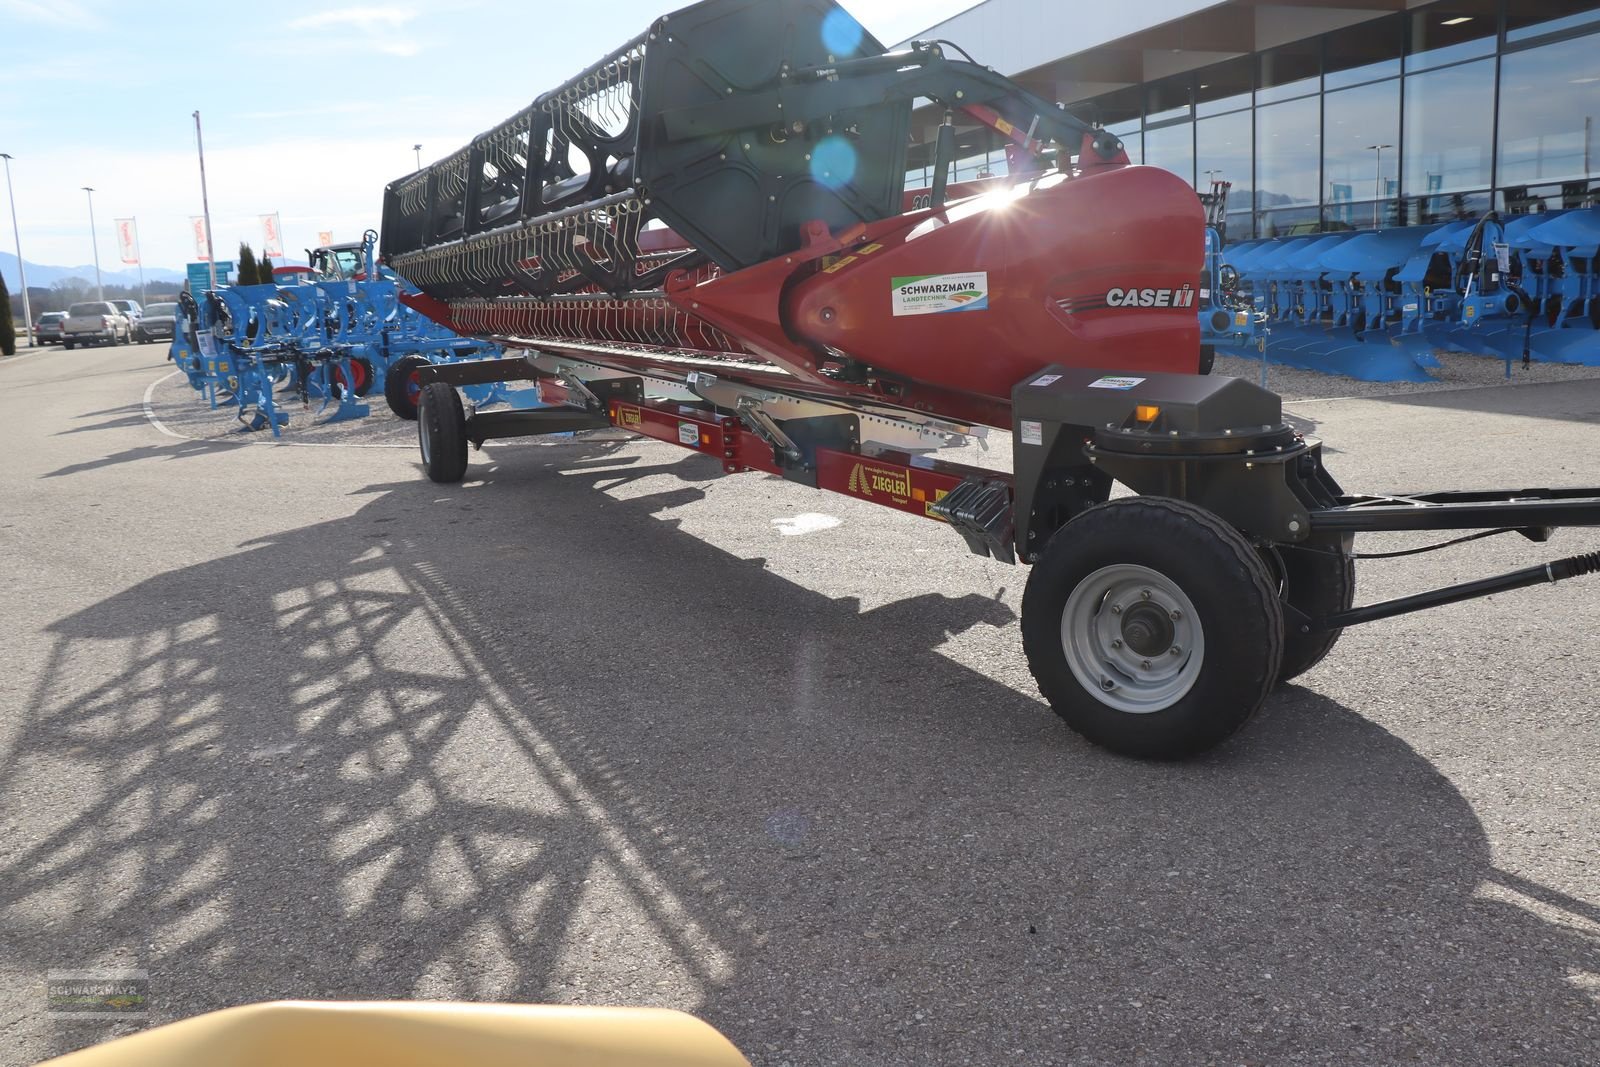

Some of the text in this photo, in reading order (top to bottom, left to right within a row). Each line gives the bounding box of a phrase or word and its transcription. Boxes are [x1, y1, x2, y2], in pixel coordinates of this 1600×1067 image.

[900, 282, 975, 295] SCHWARZMAYR
[902, 295, 947, 303] LANDTECHNIK
[1106, 287, 1171, 307] CASE
[872, 475, 907, 496] ZIEGLER
